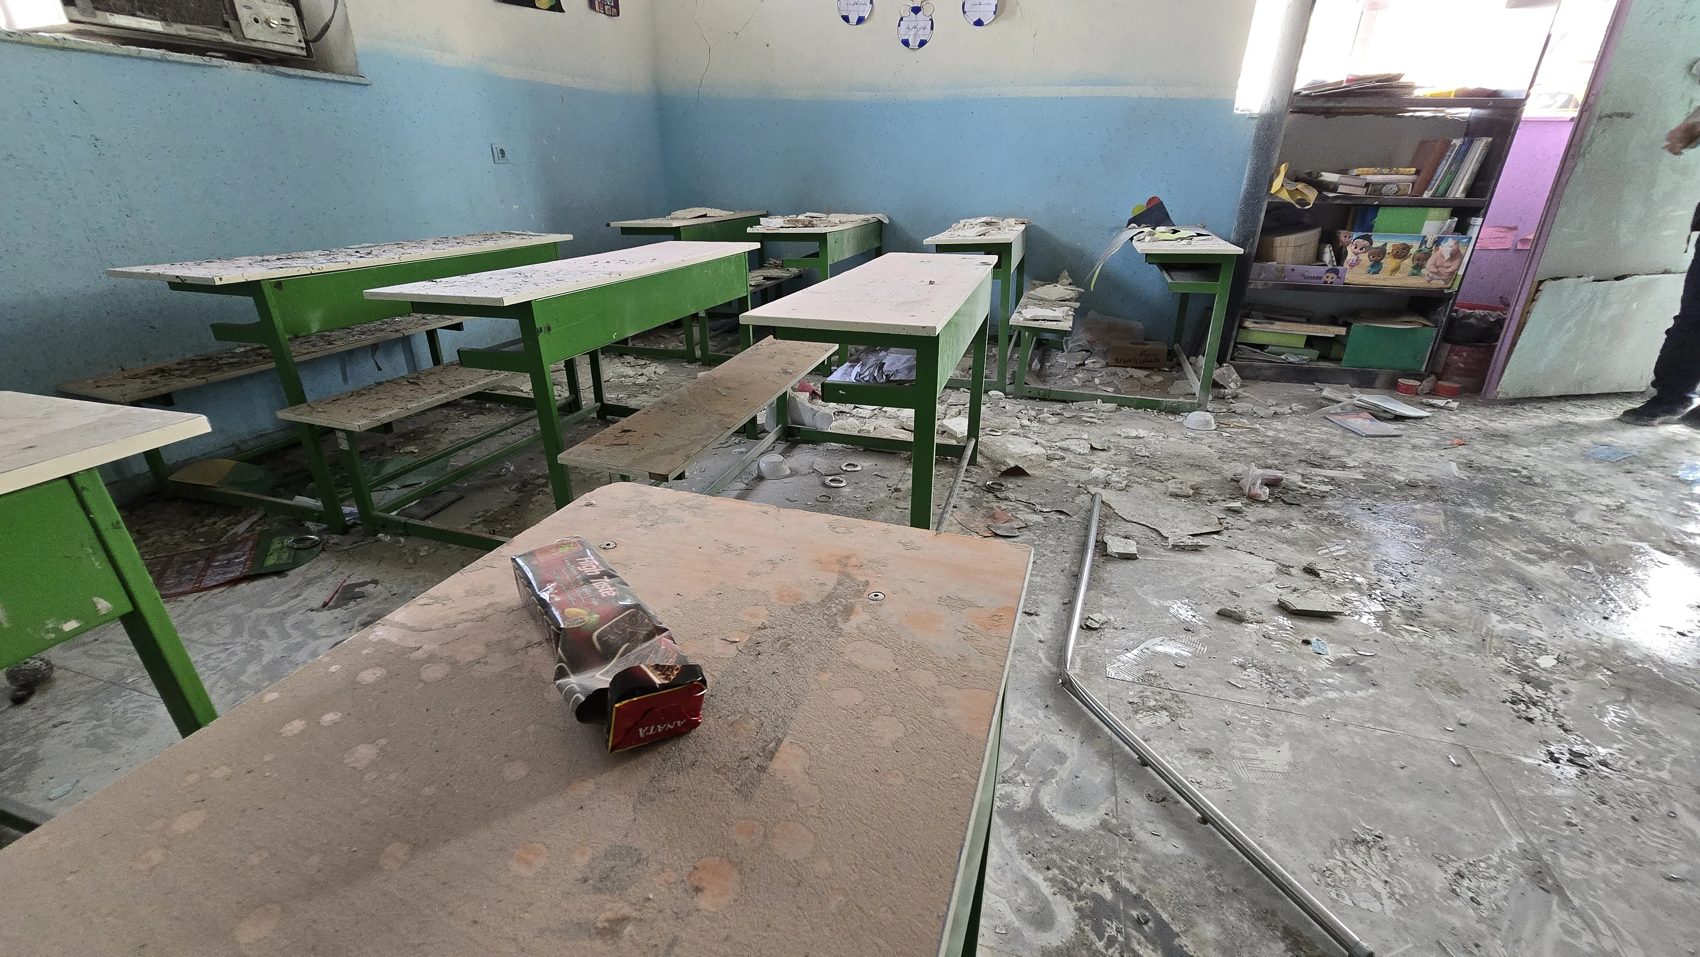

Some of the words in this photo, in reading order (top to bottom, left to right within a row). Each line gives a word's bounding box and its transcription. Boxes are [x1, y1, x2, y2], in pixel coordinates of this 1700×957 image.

[576, 556, 606, 576] High
[590, 575, 617, 597] Taste
[639, 719, 687, 738] ANATA
